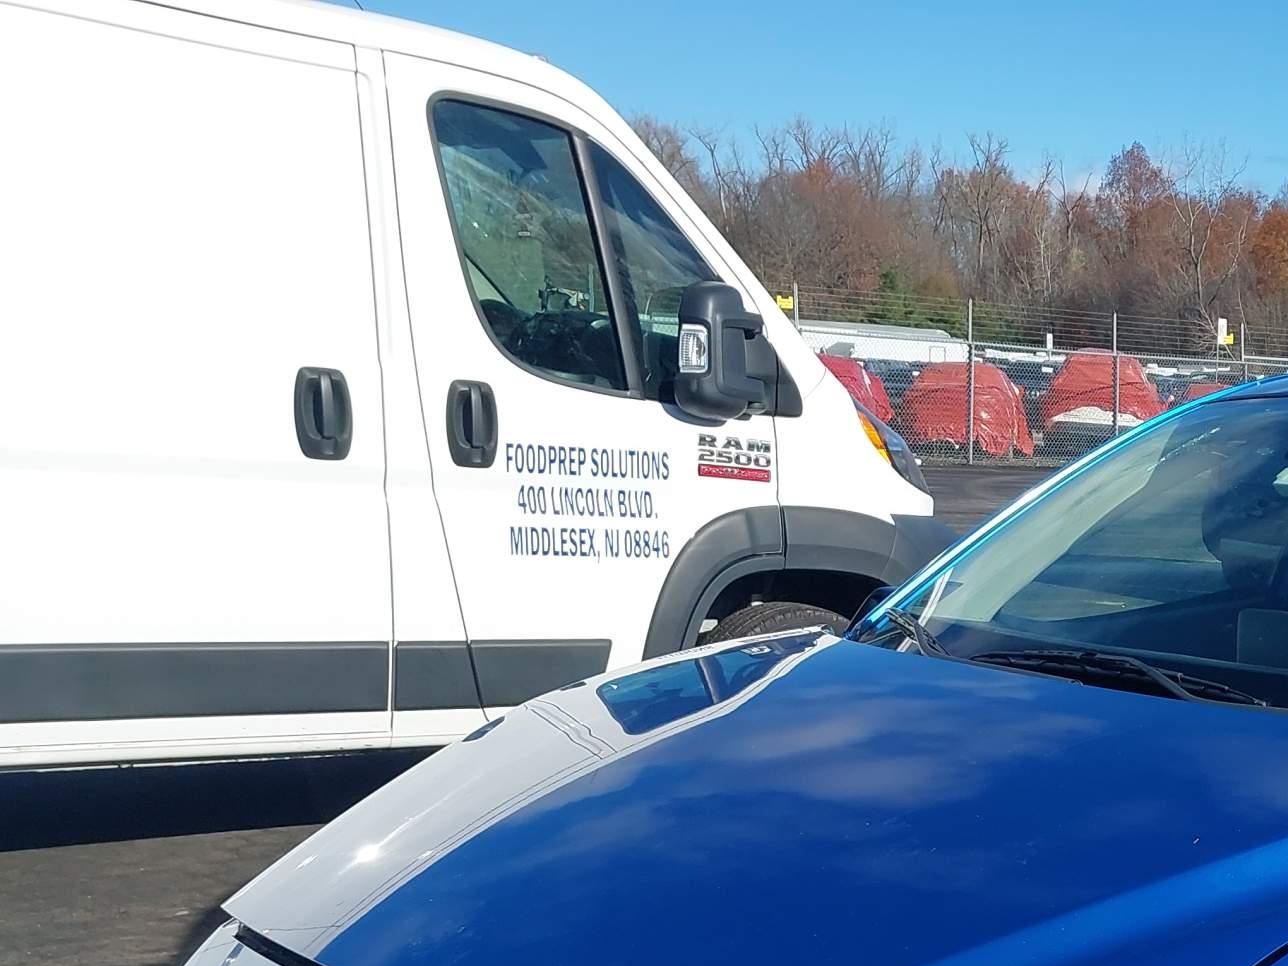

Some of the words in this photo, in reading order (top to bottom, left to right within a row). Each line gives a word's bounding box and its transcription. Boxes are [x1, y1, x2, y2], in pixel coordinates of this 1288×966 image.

[698, 433, 771, 453] RAM
[698, 448, 771, 467] 2500
[506, 443, 585, 477] FOODPREP
[591, 449, 670, 480] SOLUTIONS
[517, 485, 547, 515] 400
[551, 486, 614, 518] LINCOLN
[618, 490, 658, 519] BLVD.
[510, 526, 601, 563] MIDDLESEX,
[605, 529, 619, 558] NJ
[624, 530, 670, 559] 08846
